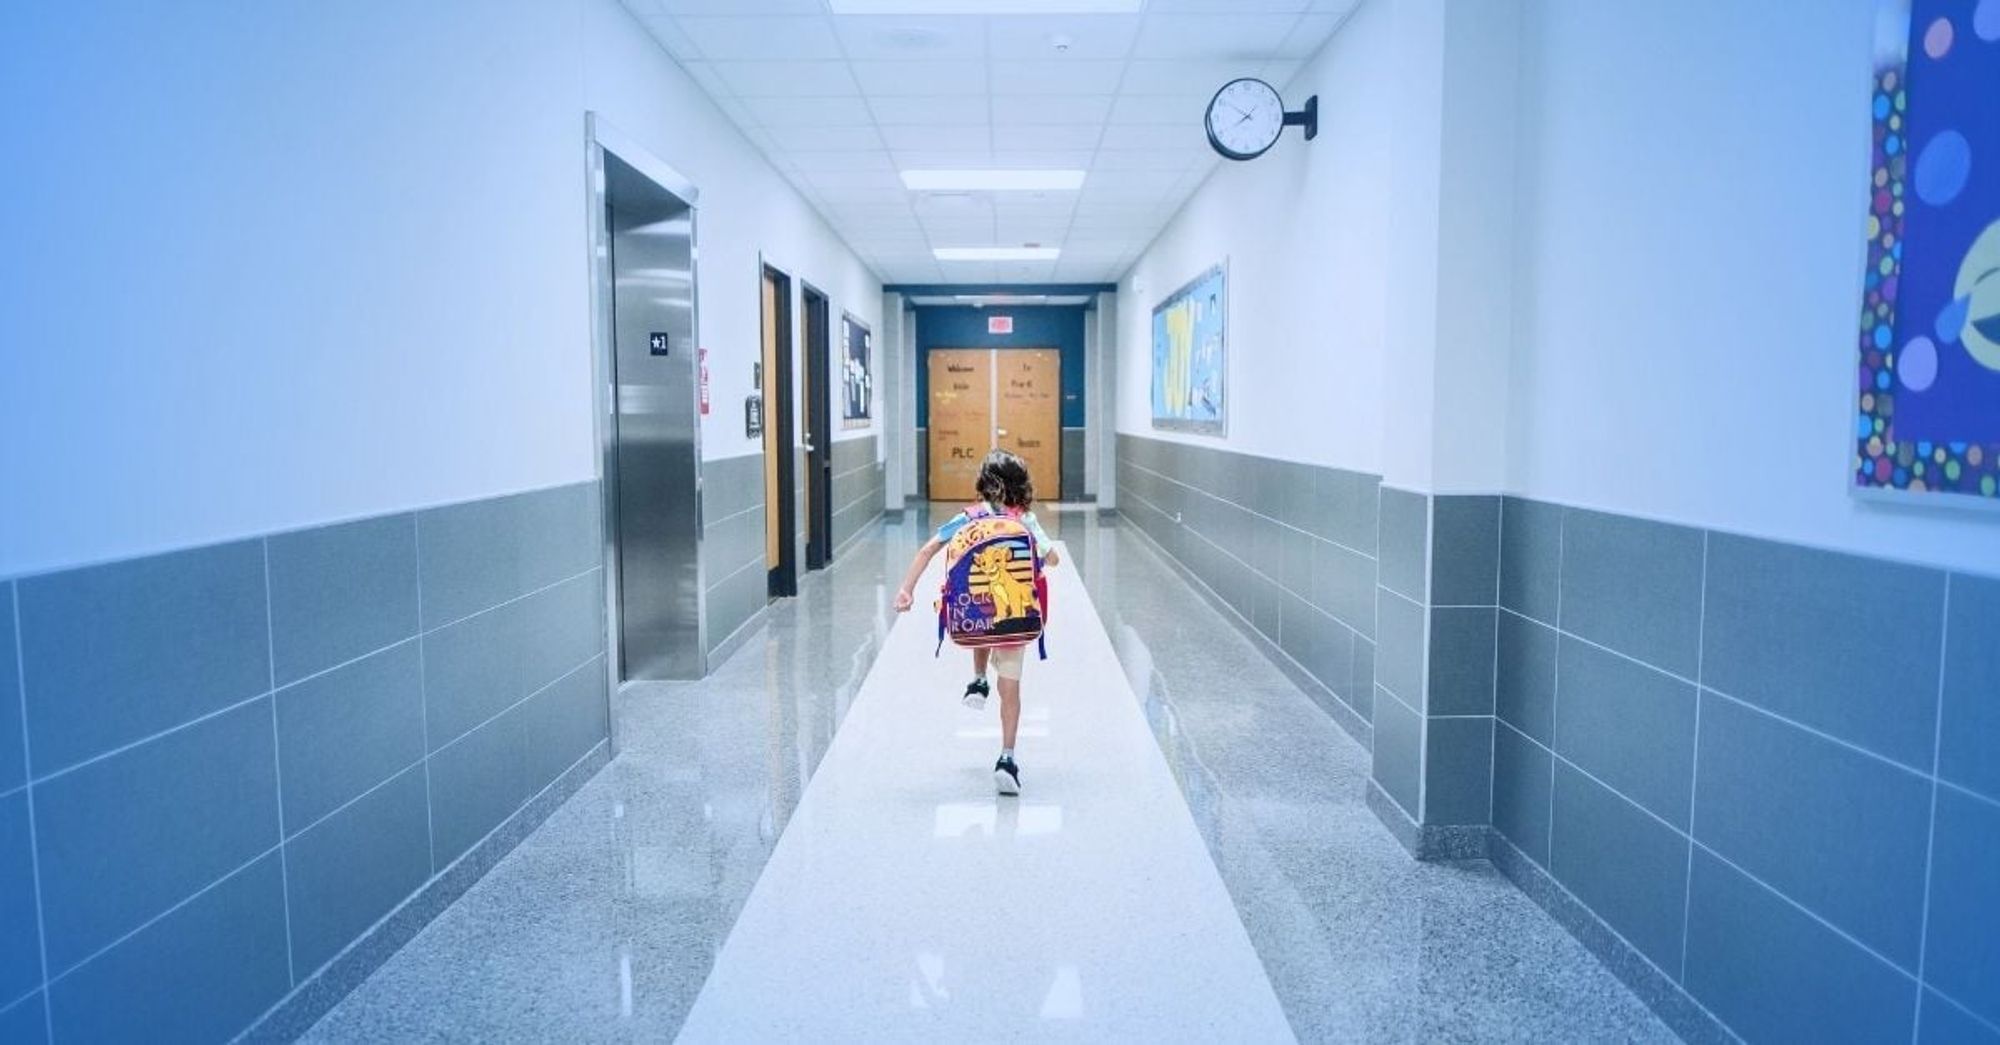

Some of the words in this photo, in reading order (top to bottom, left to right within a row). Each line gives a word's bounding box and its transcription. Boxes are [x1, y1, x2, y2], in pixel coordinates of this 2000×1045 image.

[661, 335, 667, 350] 1
[951, 447, 975, 459] PLC
[954, 592, 993, 606] OCK
[951, 618, 995, 632] ROAR
